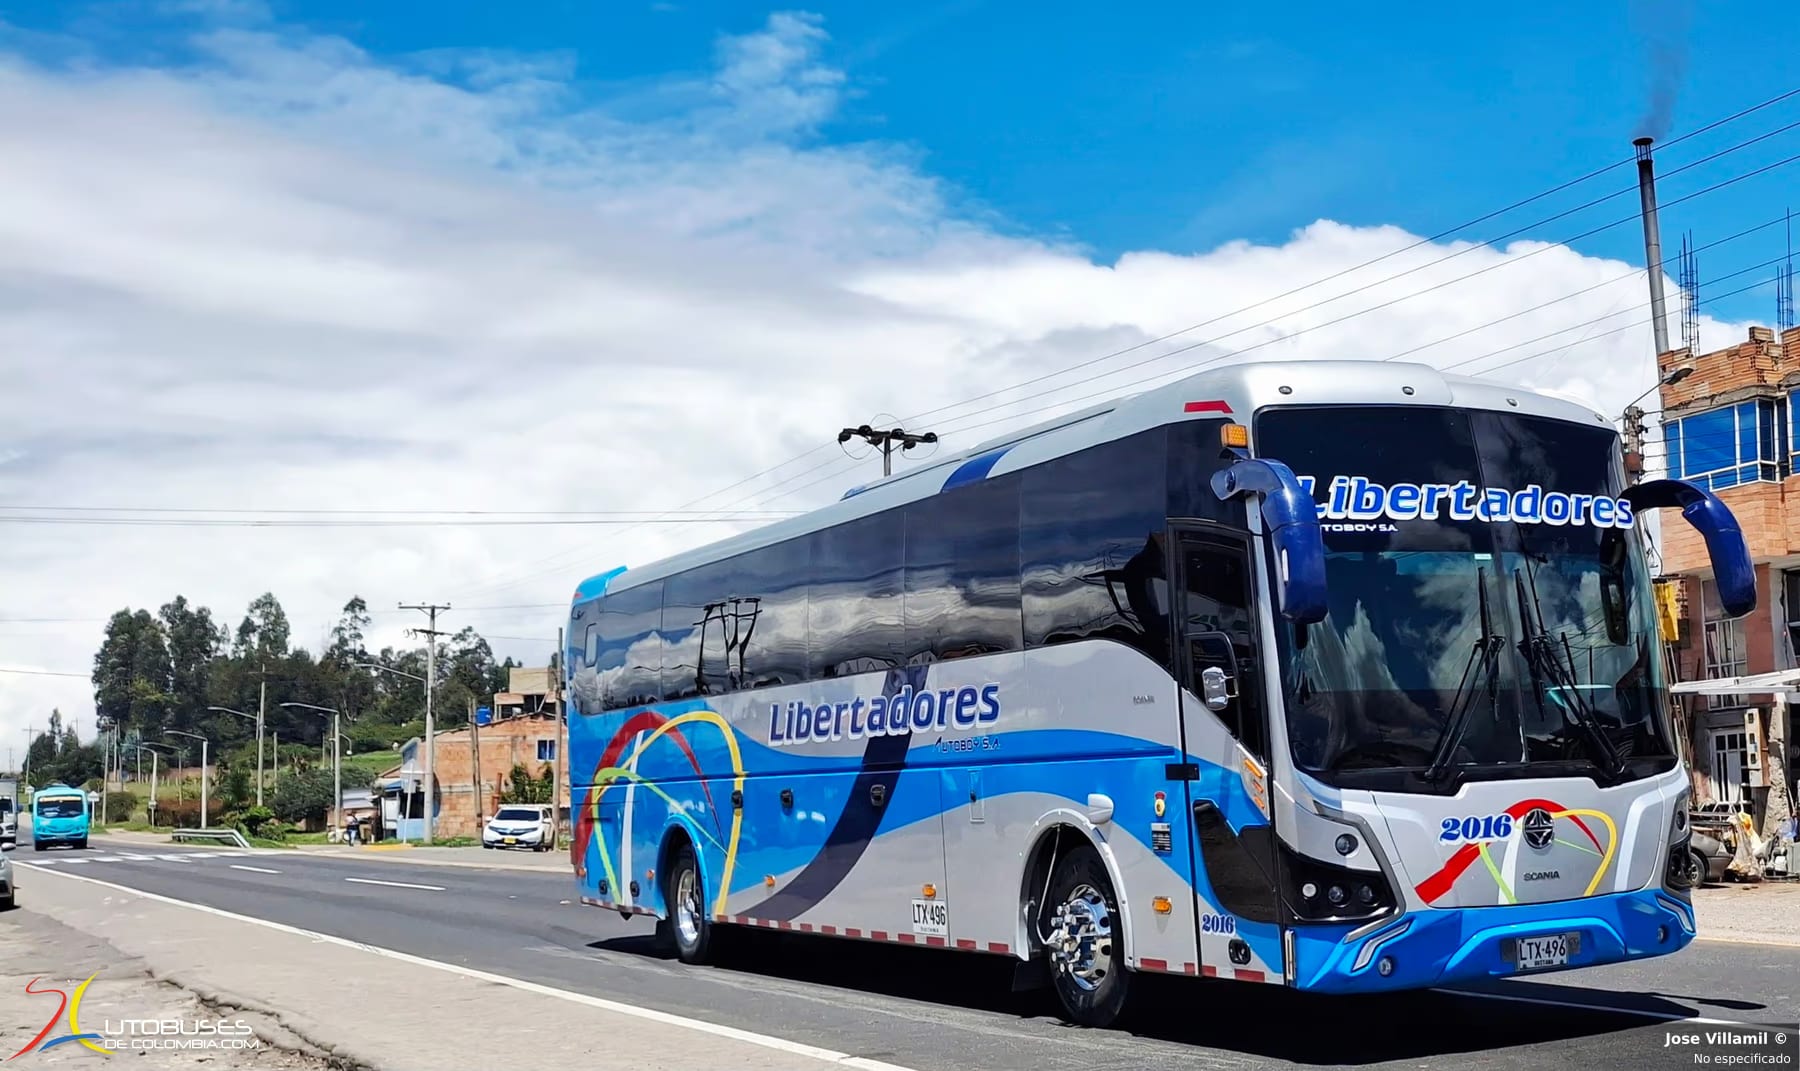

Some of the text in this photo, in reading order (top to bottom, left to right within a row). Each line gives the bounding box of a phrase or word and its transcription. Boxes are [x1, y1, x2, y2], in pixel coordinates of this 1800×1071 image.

[768, 682, 1001, 746] Libertadores
[1439, 813, 1513, 845] 2016
[1523, 870, 1560, 881] SCANIA
[1201, 913, 1236, 936] 2016
